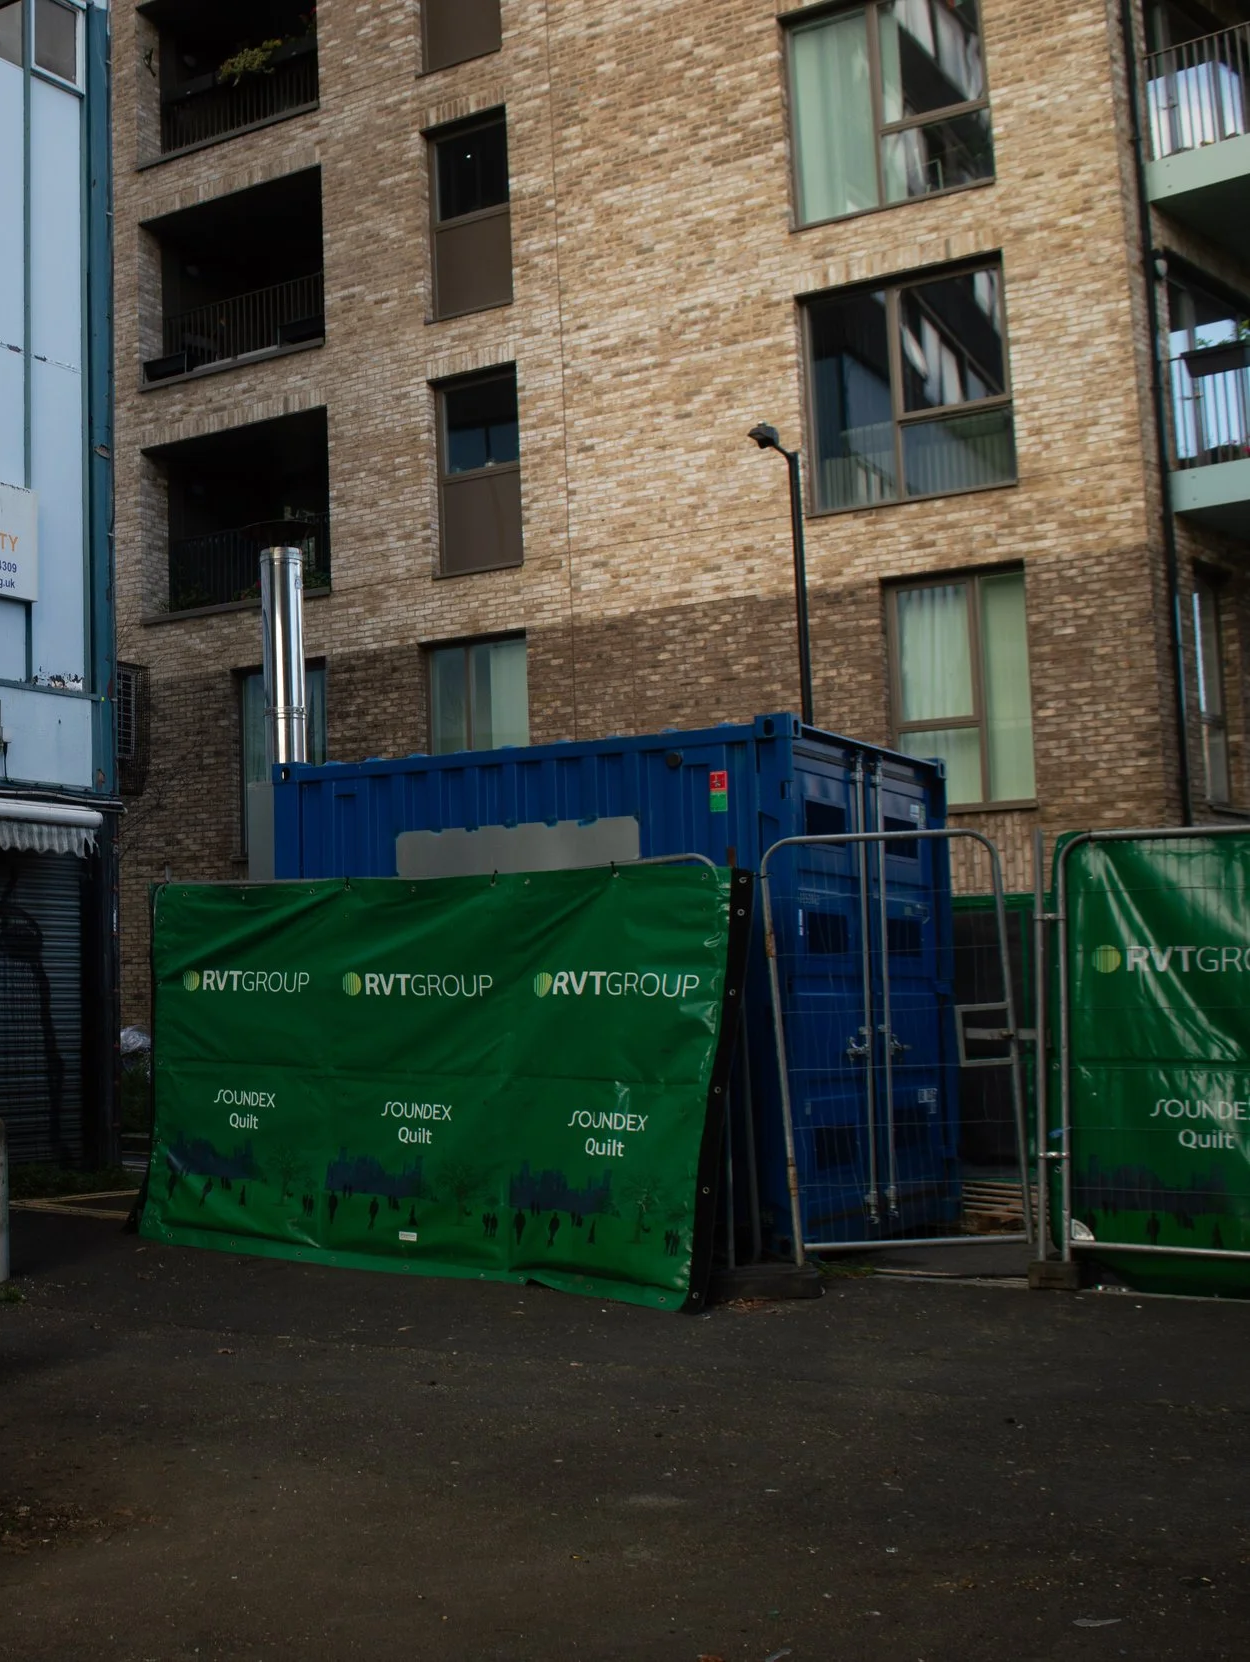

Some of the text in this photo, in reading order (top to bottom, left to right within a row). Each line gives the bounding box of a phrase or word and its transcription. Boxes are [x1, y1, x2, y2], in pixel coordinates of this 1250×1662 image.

[214, 1089, 276, 1108] SOUNDEX
[229, 1112, 259, 1129] Quilt
[381, 1101, 452, 1121] SOUNDEX
[567, 1110, 649, 1132] SOUNDEX
[398, 1126, 432, 1144] Quilt
[1178, 1128, 1235, 1149] Quilt
[585, 1137, 625, 1157] Quilt
